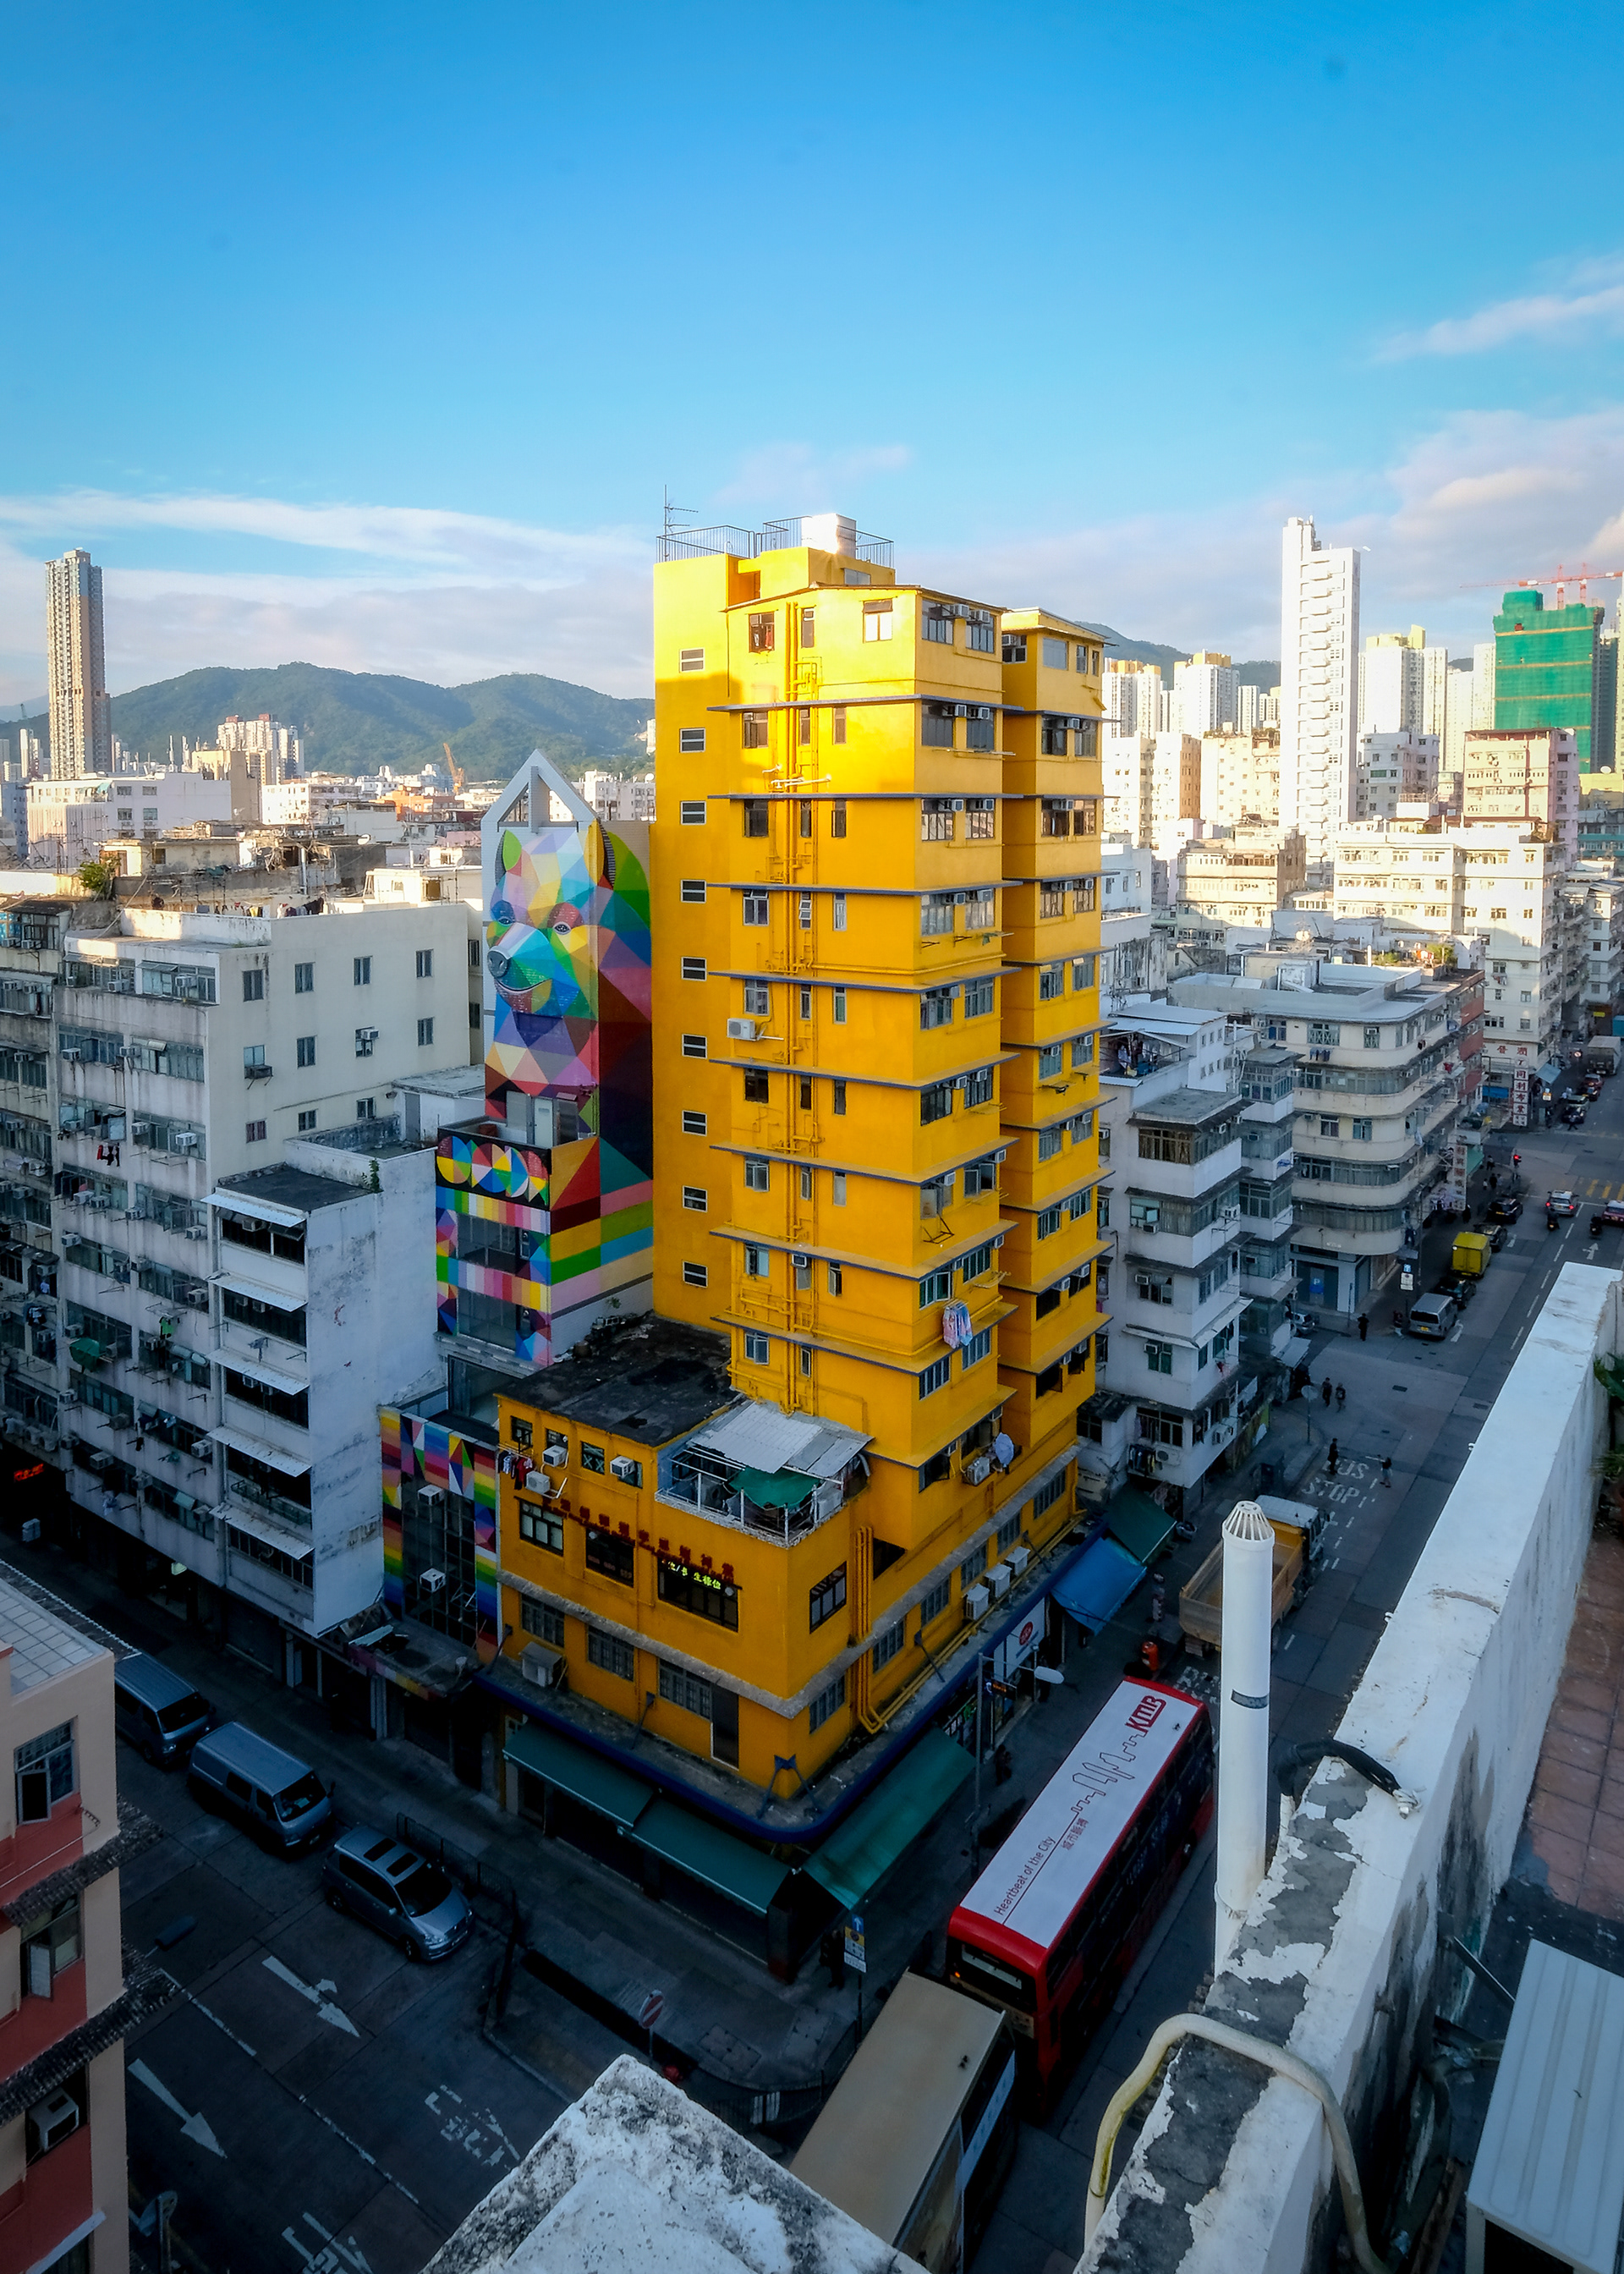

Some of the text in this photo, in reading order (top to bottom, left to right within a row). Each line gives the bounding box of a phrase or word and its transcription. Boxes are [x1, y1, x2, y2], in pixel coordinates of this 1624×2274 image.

[1301, 1476, 1360, 1504] STOP
[1125, 1695, 1166, 1733] KMB
[994, 1836, 1056, 1915] Heartbeat of the City
